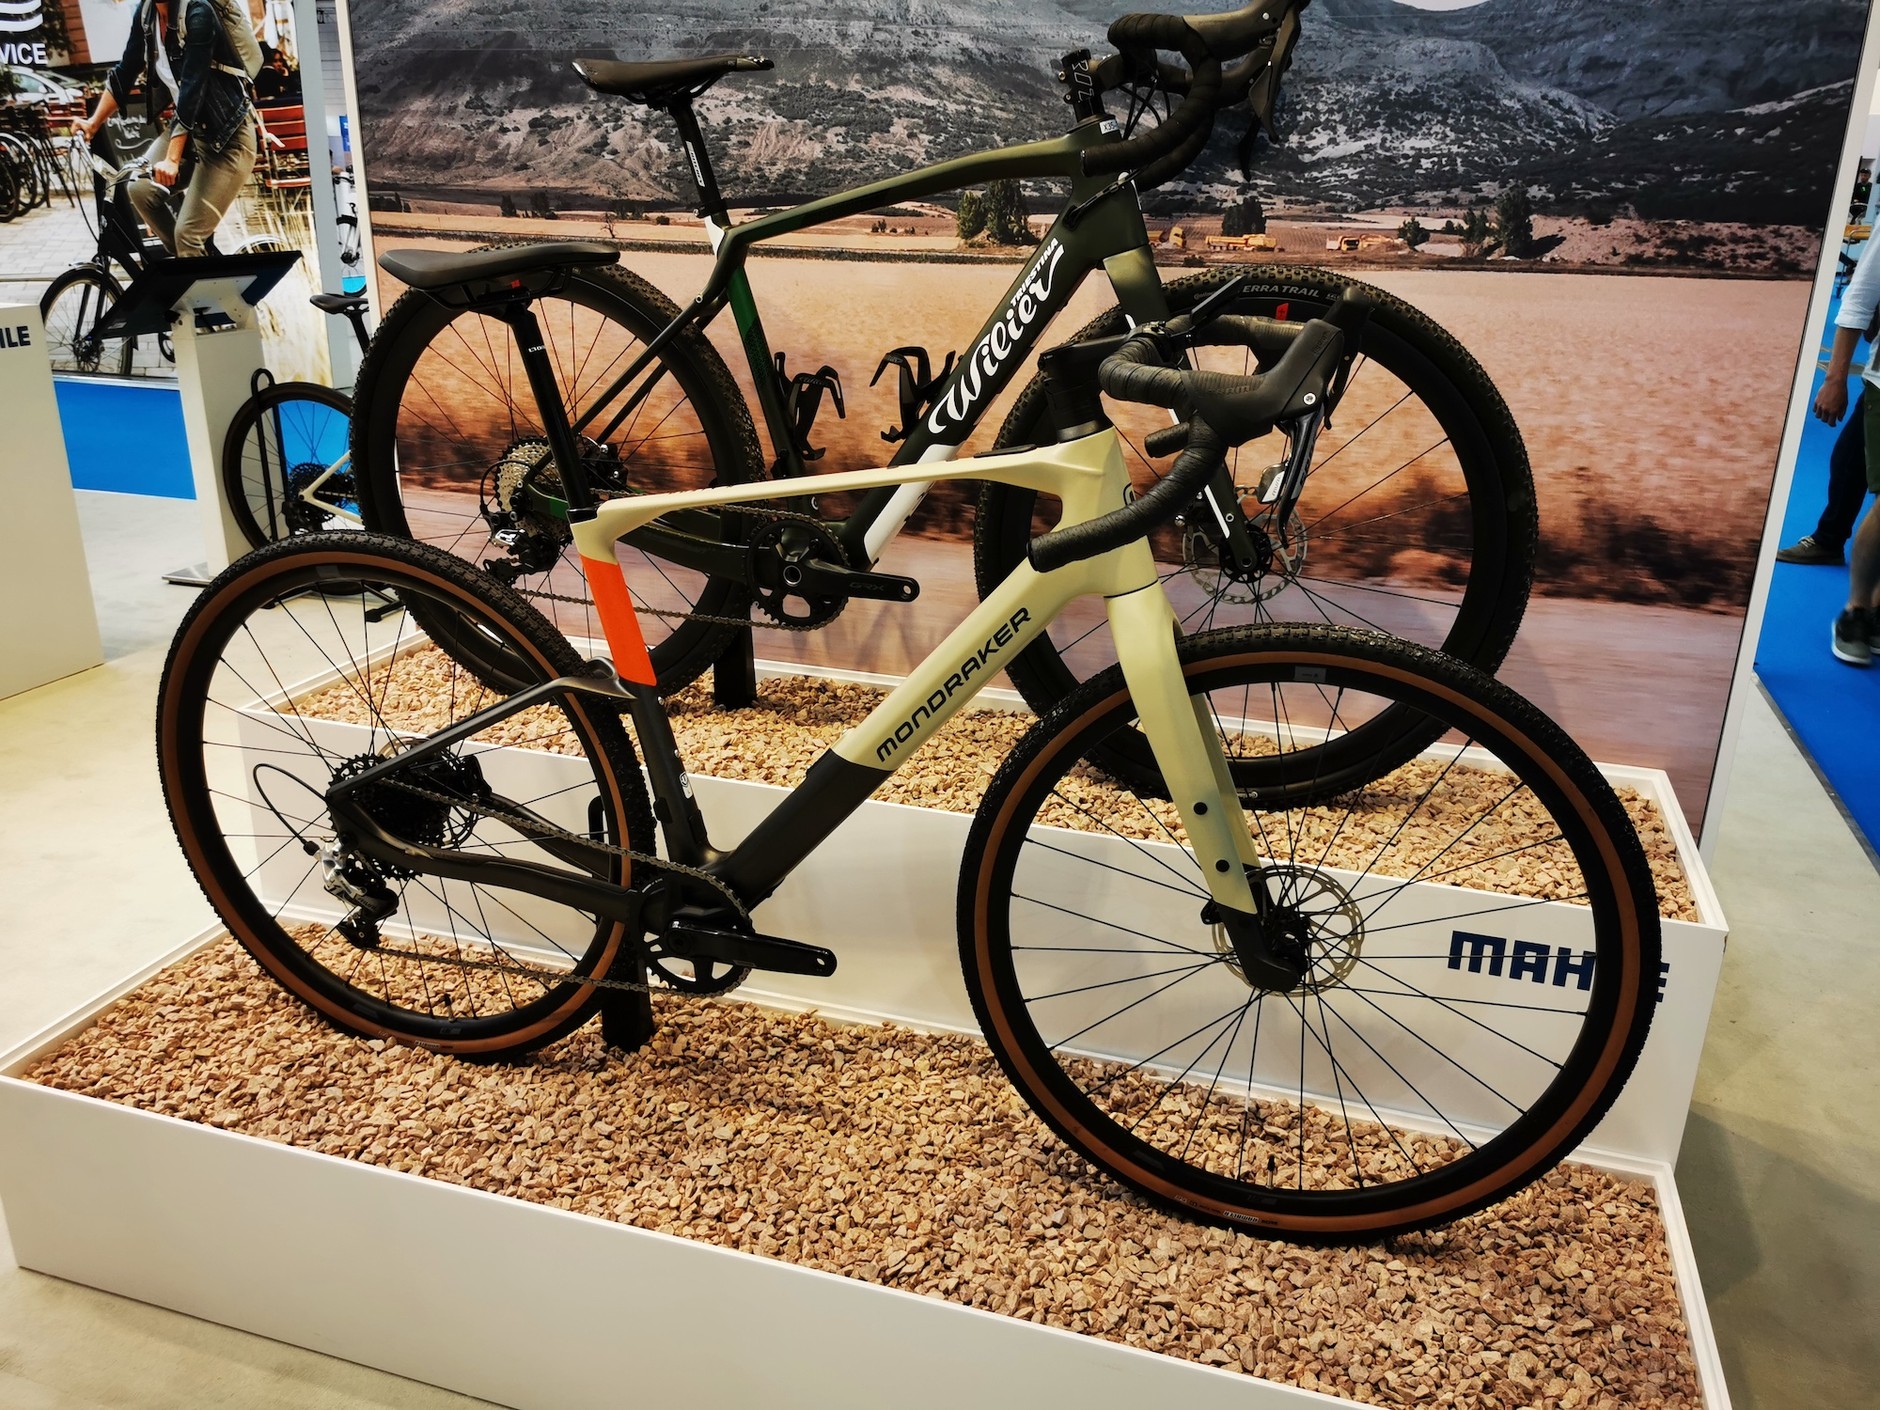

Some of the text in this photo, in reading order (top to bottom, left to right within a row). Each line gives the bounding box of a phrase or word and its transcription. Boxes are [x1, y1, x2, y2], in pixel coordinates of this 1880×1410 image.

[1010, 237, 1059, 307] TRIESTINA
[1241, 284, 1282, 293] ERRA
[928, 244, 1064, 434] Wilier
[876, 607, 1032, 763] MONDRAKER
[1447, 930, 1671, 1003] MAH
